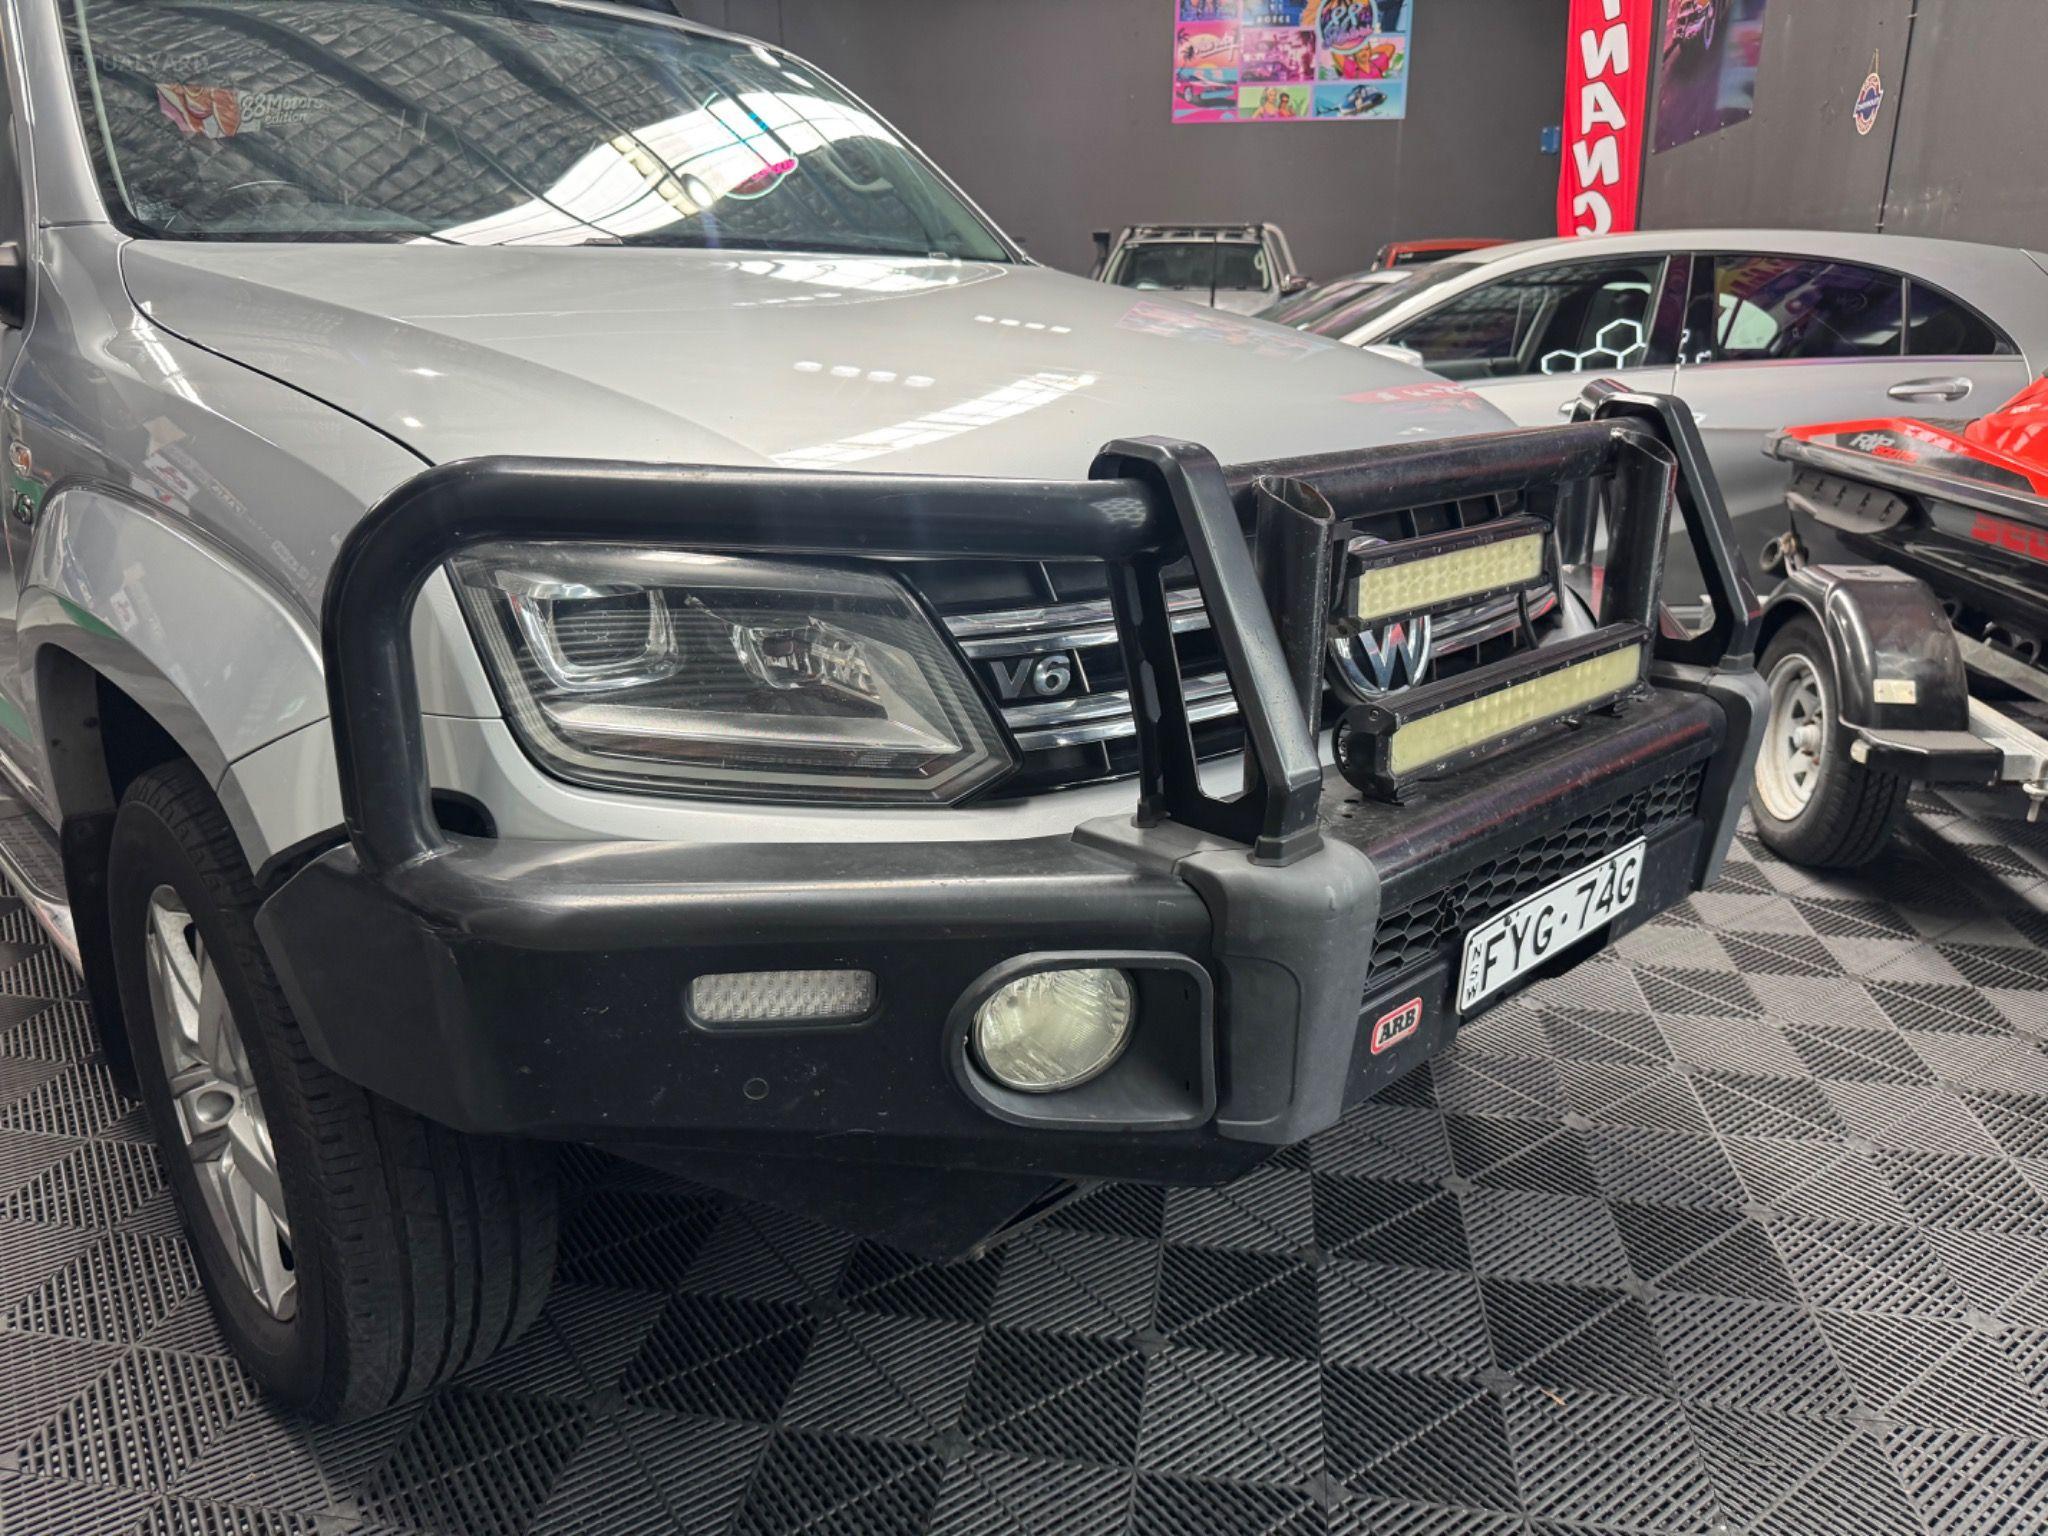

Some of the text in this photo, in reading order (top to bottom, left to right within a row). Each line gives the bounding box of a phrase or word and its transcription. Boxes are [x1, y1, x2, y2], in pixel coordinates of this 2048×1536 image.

[989, 655, 1071, 699] V6
[1466, 942, 1483, 1001] NSW
[1378, 1008, 1416, 1045] ARB
